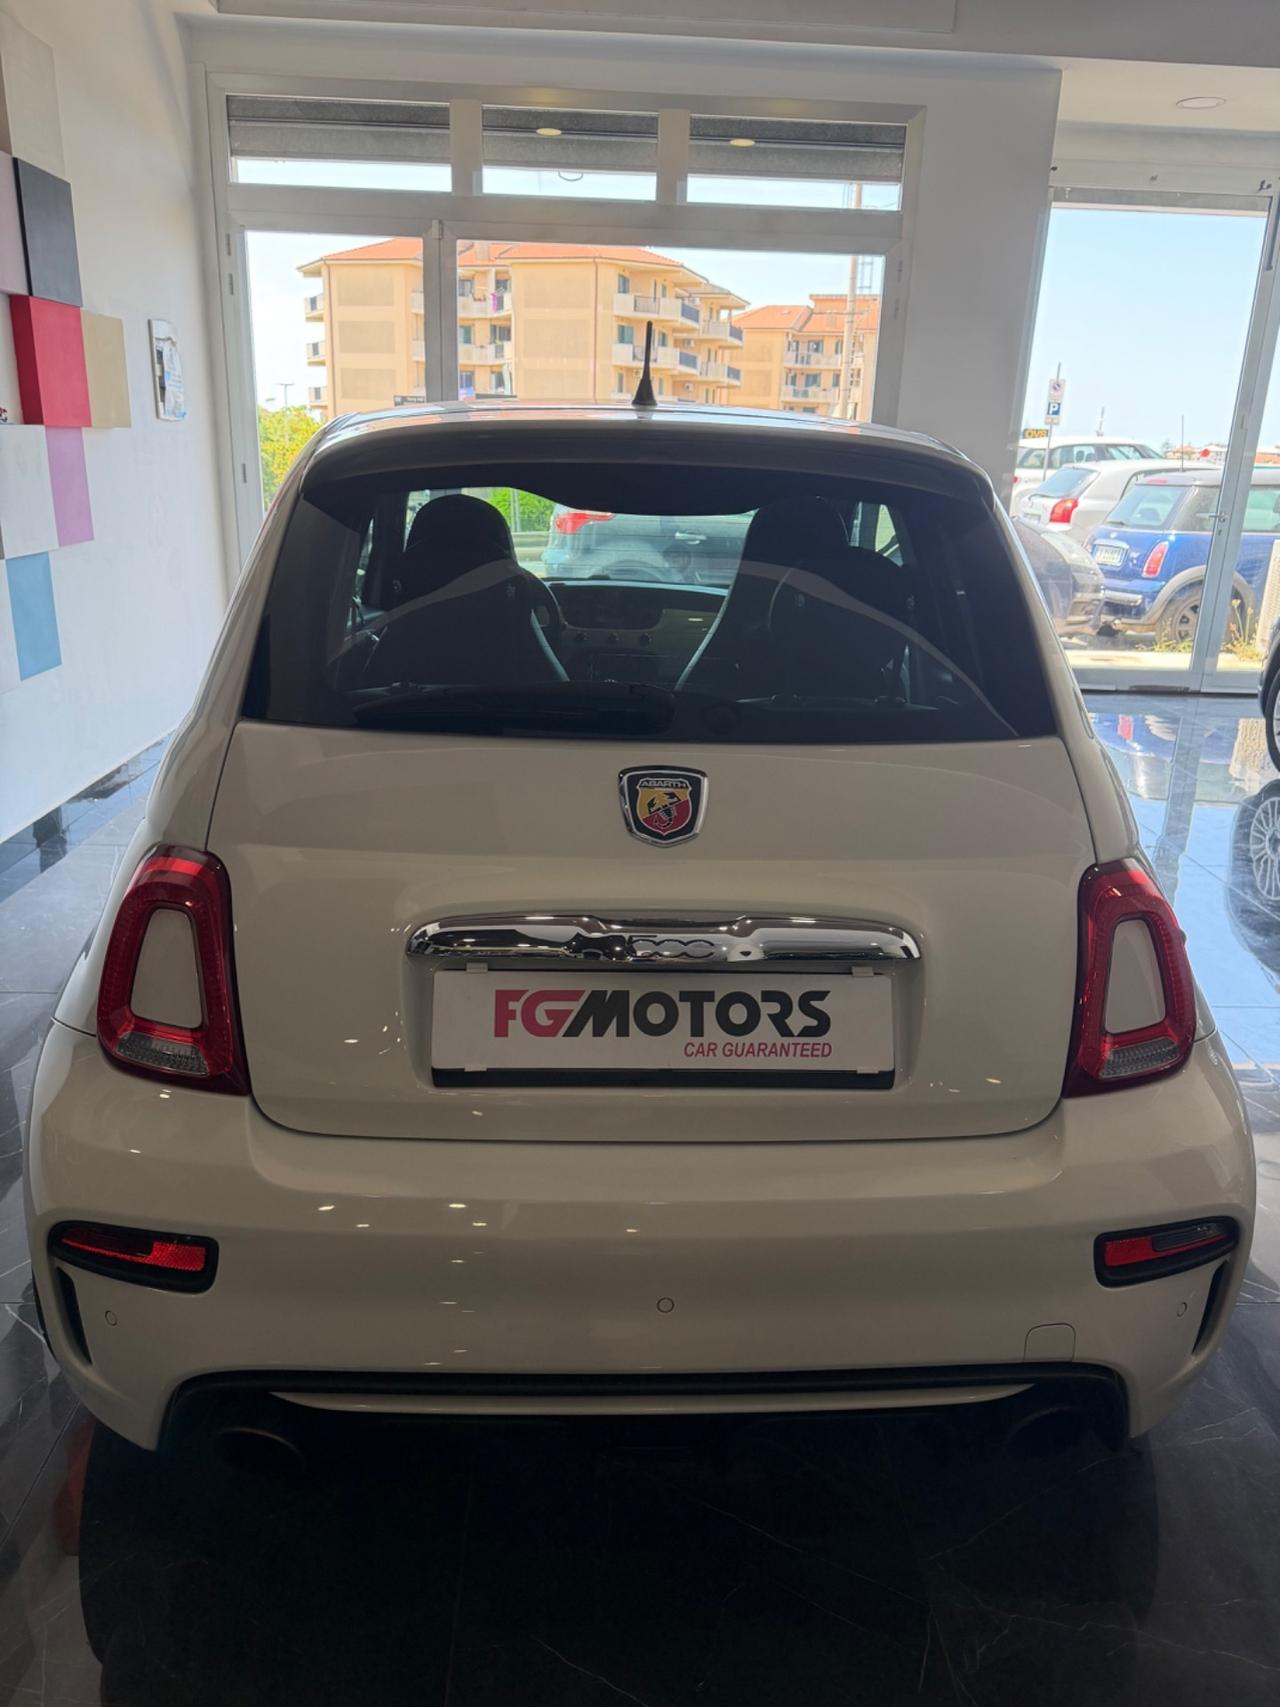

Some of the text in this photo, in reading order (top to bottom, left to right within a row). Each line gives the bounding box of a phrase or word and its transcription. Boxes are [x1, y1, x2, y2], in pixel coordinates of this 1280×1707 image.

[1049, 402, 1059, 415] P
[641, 780, 687, 788] ABARTH
[683, 1041, 833, 1058] CAR GUARANTEED
